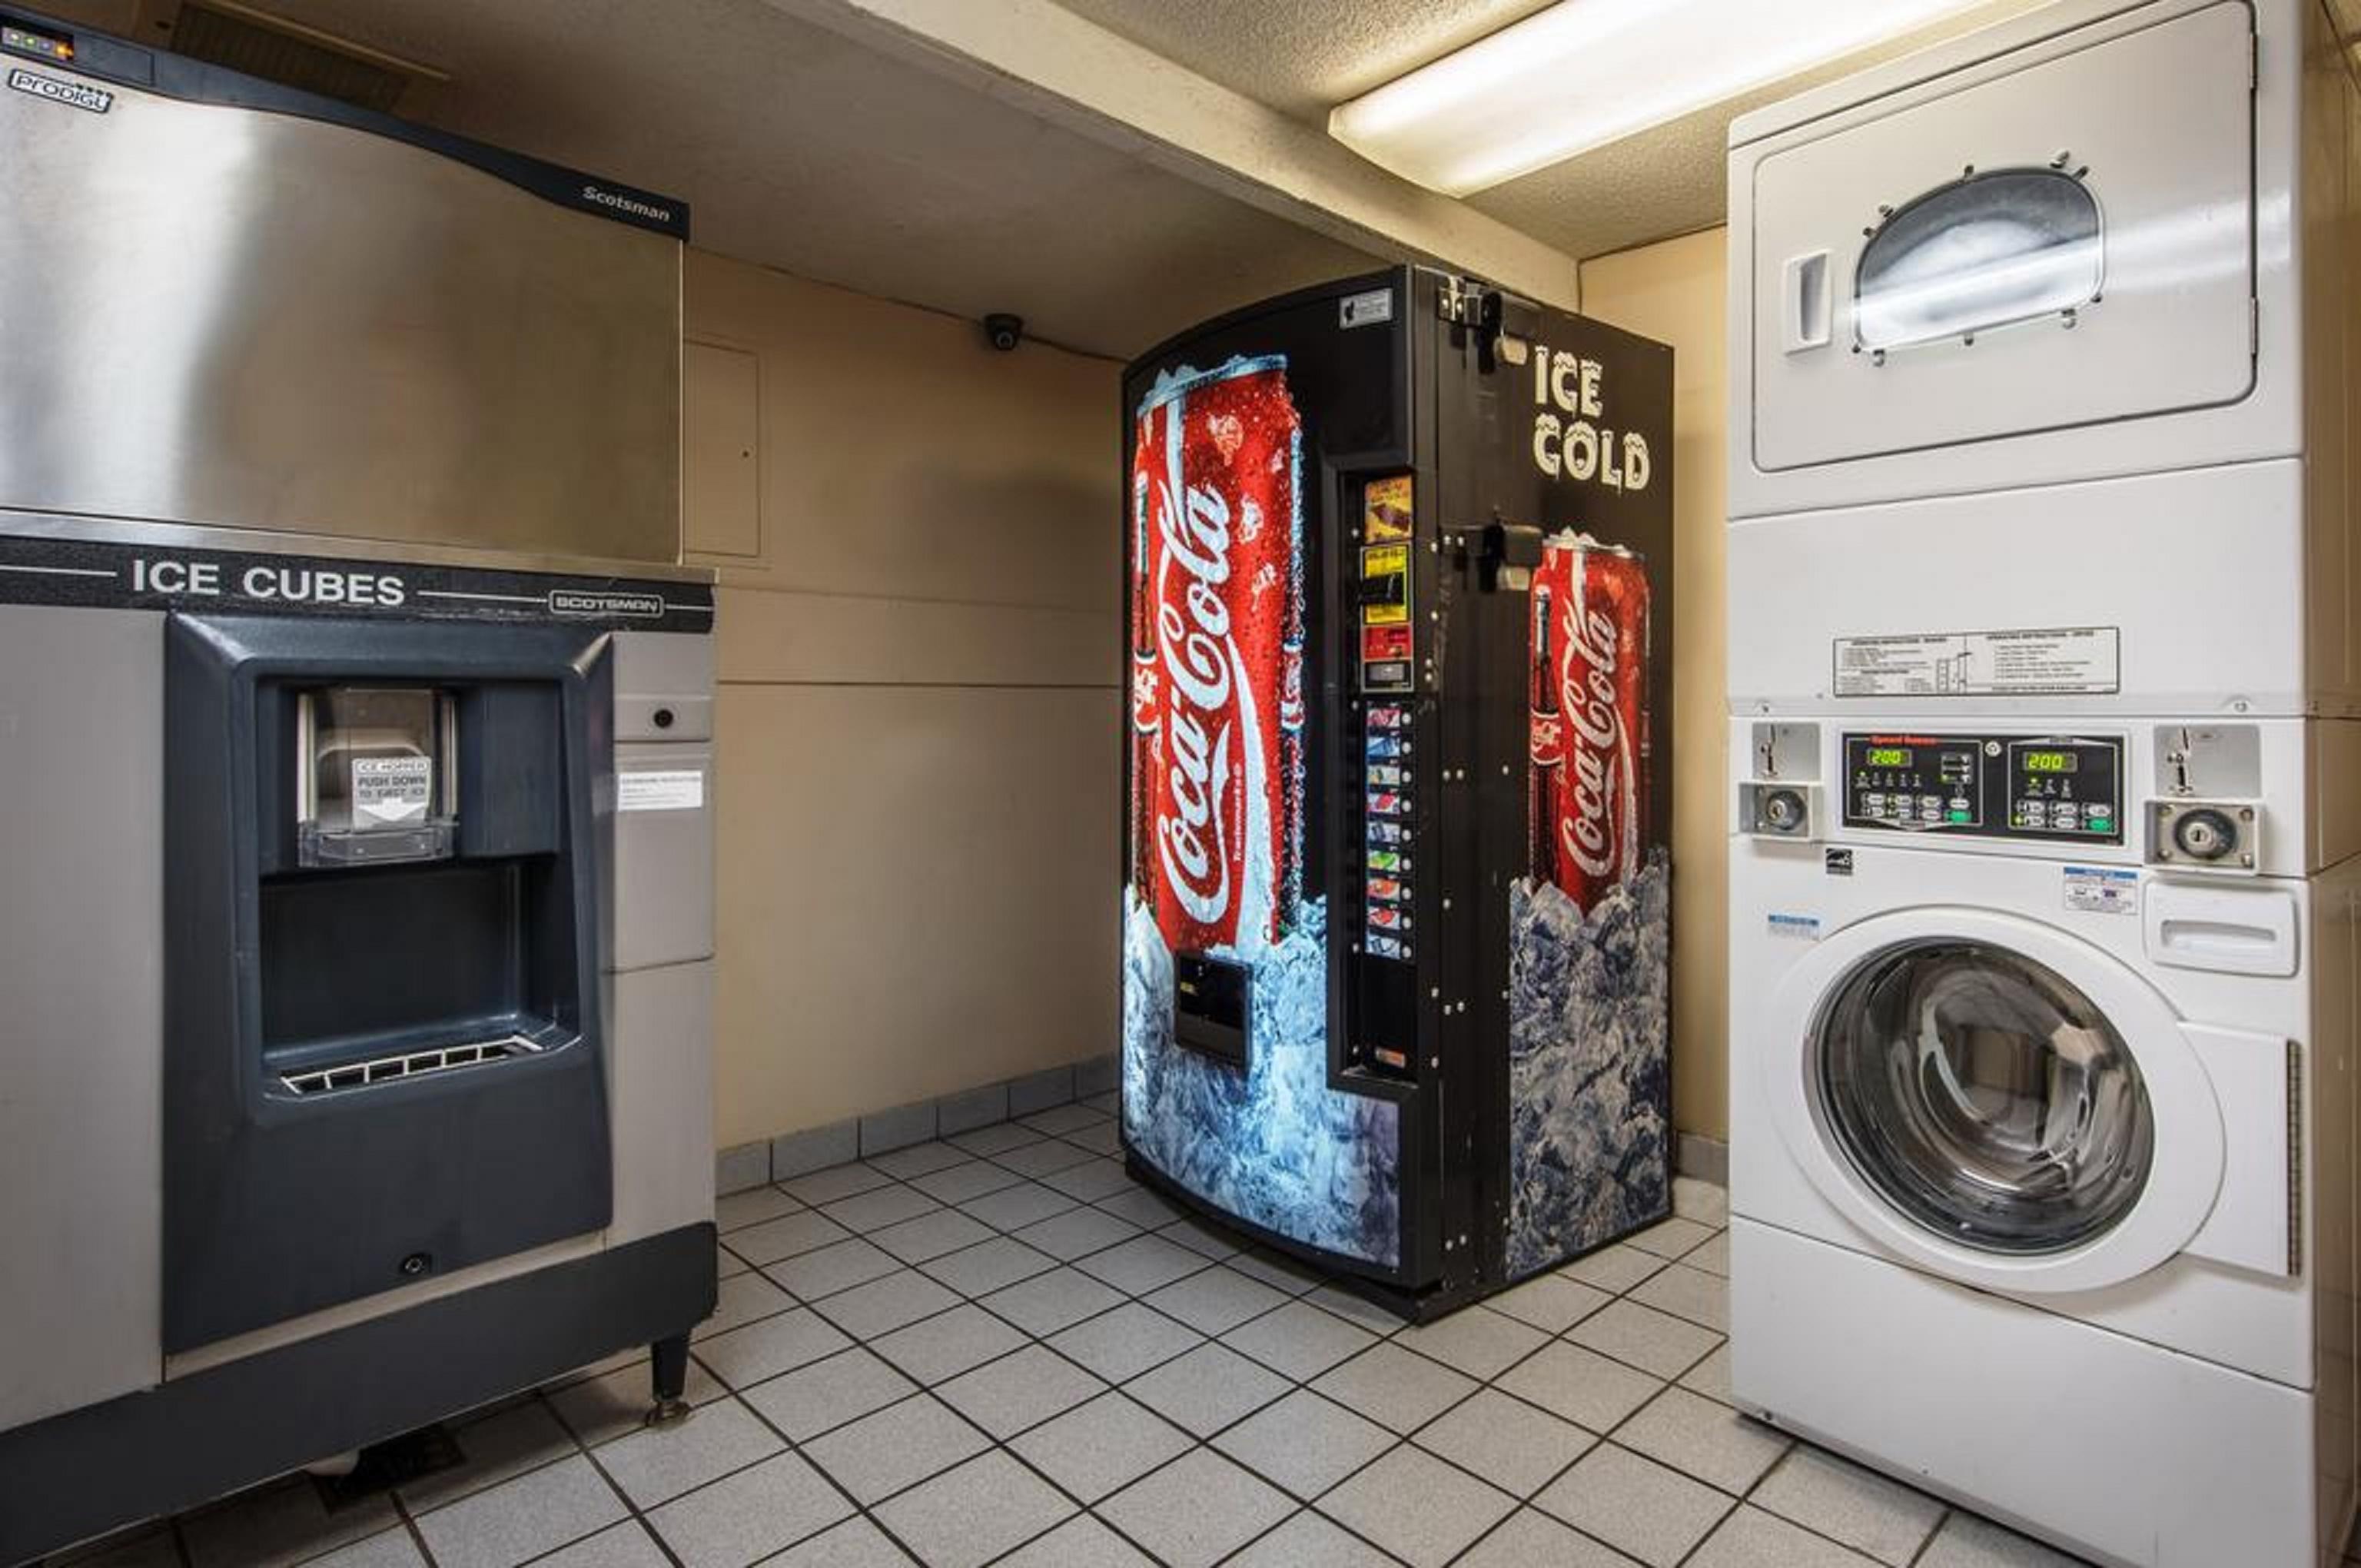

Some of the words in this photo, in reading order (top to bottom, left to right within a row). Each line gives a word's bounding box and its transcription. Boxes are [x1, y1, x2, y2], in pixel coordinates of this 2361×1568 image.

[582, 186, 670, 221] Scotsman
[1534, 345, 1602, 417] ICE
[1533, 413, 1651, 494] COLD
[133, 560, 221, 596] ICE
[242, 566, 405, 606] CUBES
[556, 596, 659, 613] SCOTSMAN
[1157, 478, 1231, 924] Coca-Cola
[1562, 596, 1617, 877] Coca-Cola
[2028, 754, 2063, 769] 200
